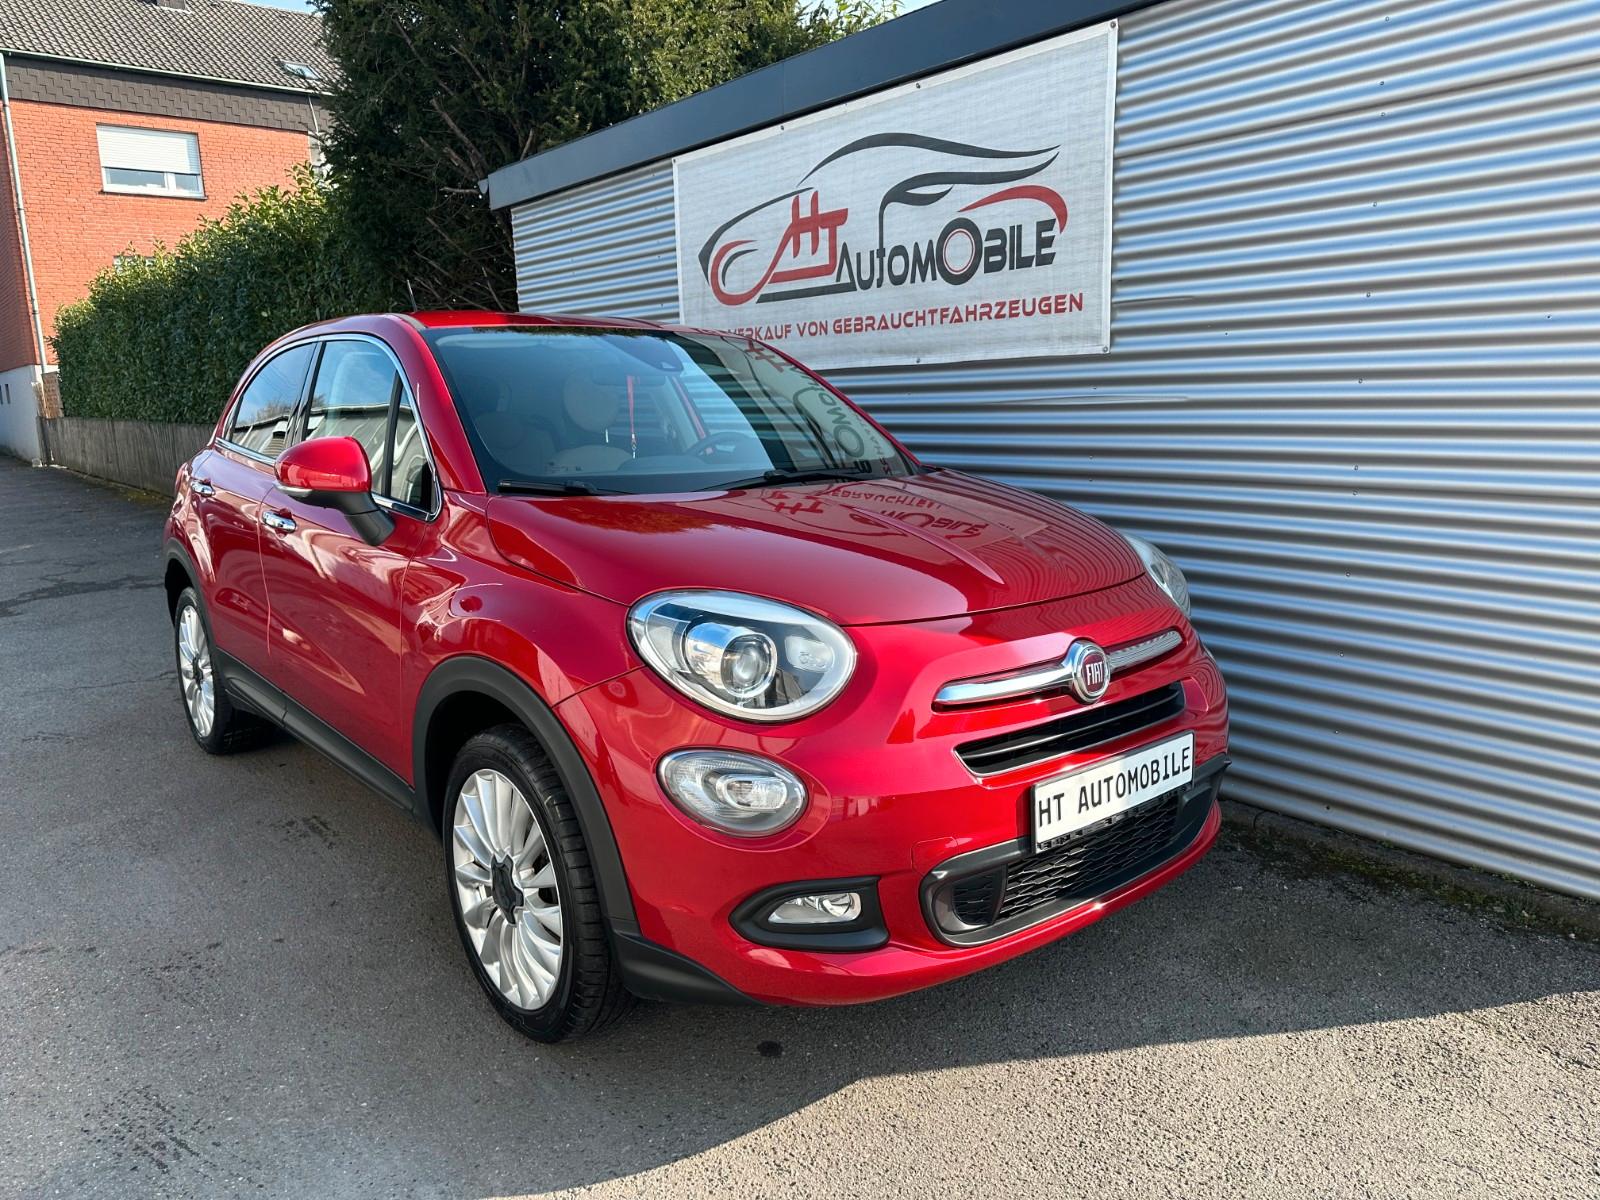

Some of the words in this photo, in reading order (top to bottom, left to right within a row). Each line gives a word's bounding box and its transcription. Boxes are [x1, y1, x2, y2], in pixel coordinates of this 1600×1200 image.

[787, 190, 848, 270] HT
[835, 216, 1057, 292] AUTOMOBILE
[796, 320, 828, 337] VON
[832, 293, 1084, 335] GEBRAUCHTFAHRZEUGEN
[1087, 661, 1104, 686] FIAT
[1038, 792, 1065, 828] HT
[1077, 746, 1191, 814] AUTOMOBILE
